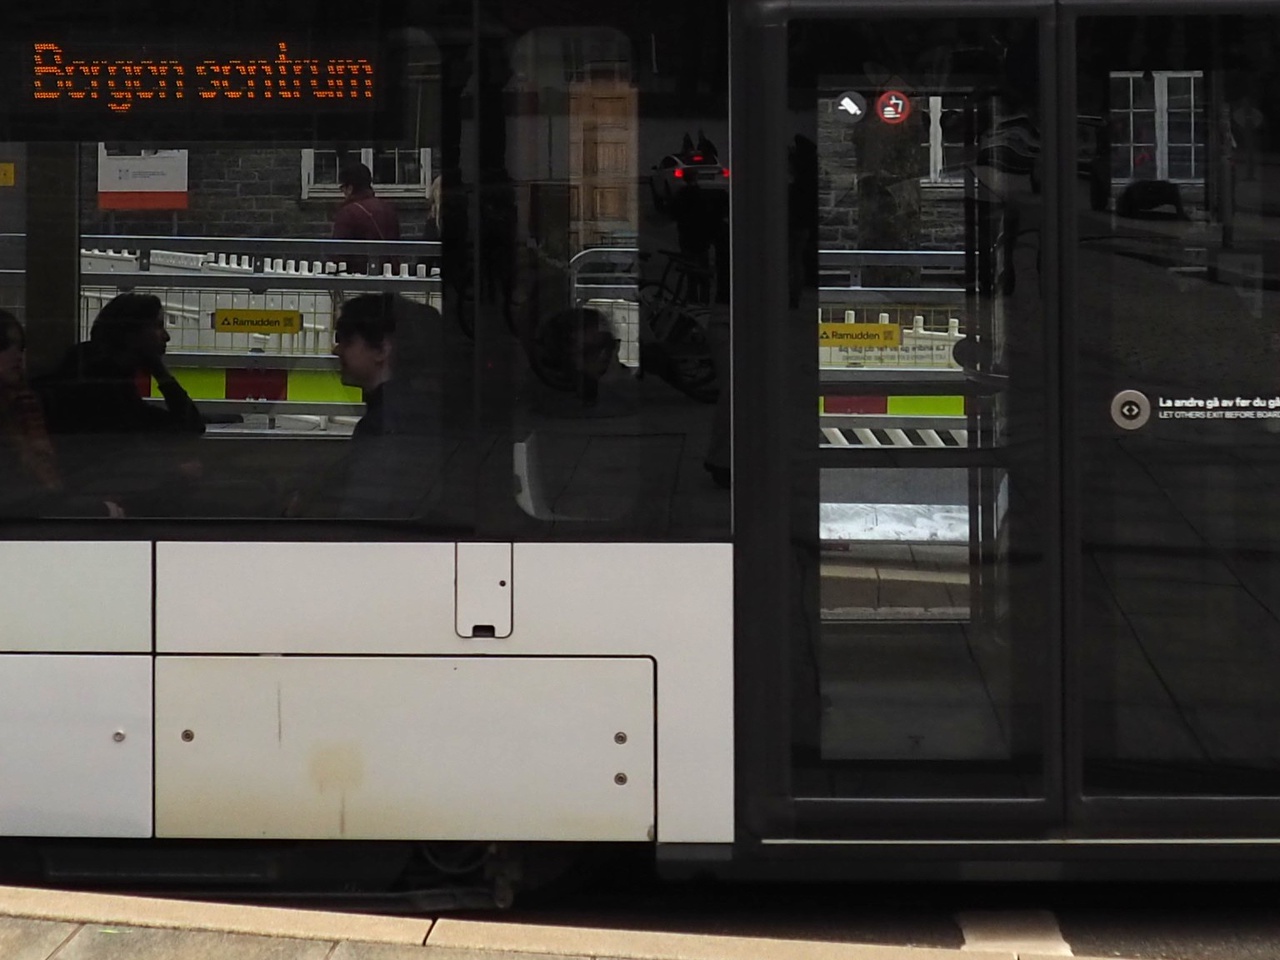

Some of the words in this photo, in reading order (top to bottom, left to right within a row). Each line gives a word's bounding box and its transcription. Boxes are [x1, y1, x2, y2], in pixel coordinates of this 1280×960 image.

[232, 317, 280, 327] Ramudden
[831, 330, 880, 340] Ramudden
[1159, 397, 1173, 407] La
[1174, 397, 1205, 408] andre
[1221, 399, 1234, 407] av
[1252, 397, 1267, 407] du
[1159, 411, 1174, 419] LET
[1174, 411, 1206, 419] OTHERS
[1207, 411, 1223, 419] EXIT
[1224, 411, 1256, 419] BEFORE
